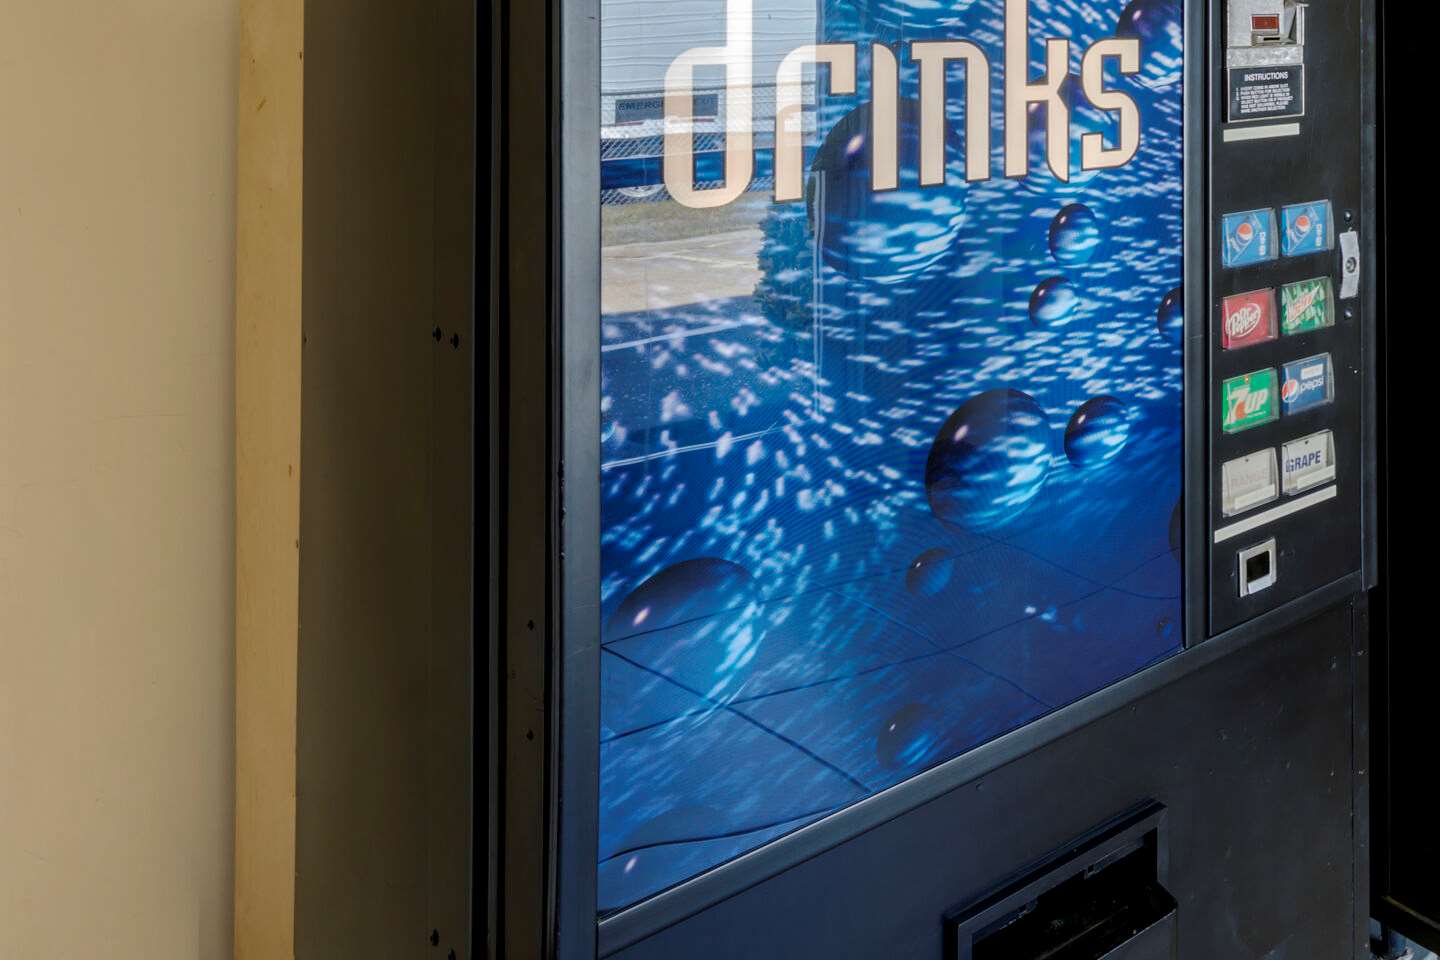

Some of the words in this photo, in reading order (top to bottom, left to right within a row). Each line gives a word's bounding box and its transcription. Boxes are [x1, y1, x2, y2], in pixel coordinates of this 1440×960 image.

[1244, 71, 1289, 82] INSTRUCTIONS
[1300, 376, 1325, 395] pepsi
[1285, 450, 1321, 473] GRAPE
